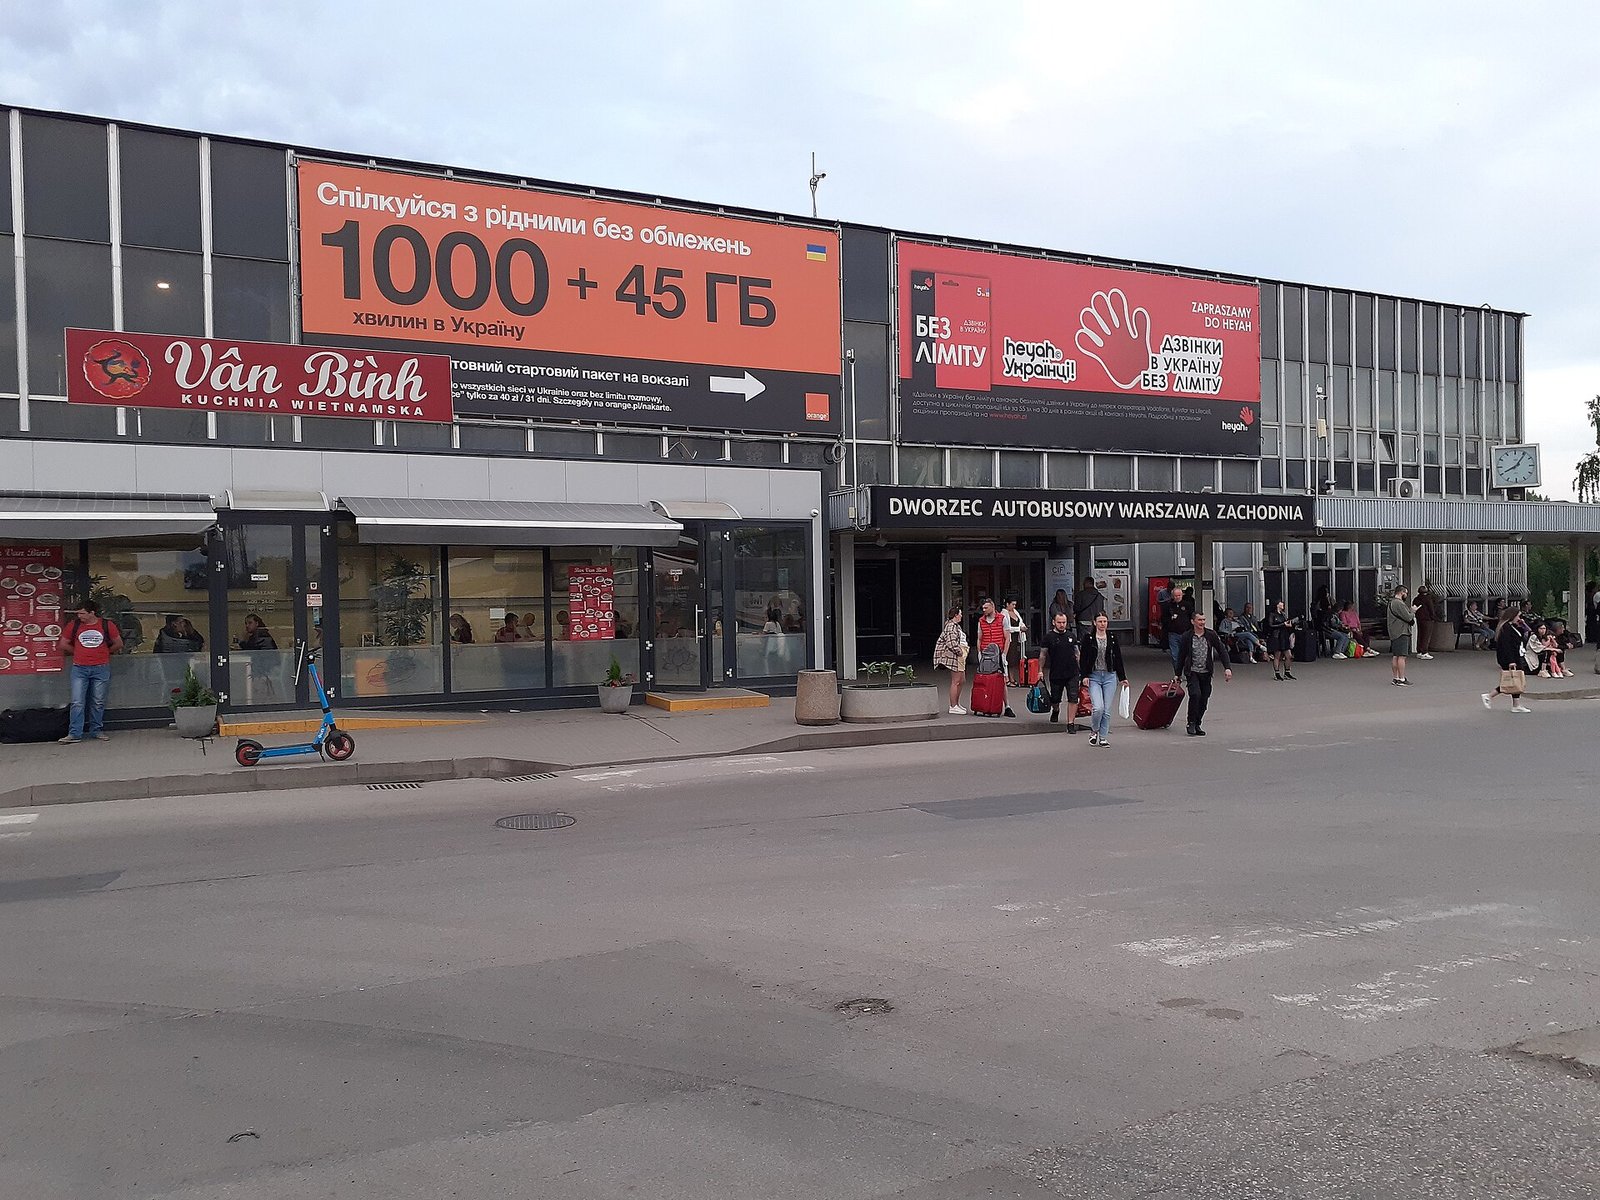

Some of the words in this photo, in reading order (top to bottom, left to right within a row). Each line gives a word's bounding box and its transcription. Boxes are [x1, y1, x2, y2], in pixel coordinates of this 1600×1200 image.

[317, 182, 457, 220] Спілкуйся
[463, 205, 479, 222] з
[485, 204, 587, 235] рідними
[593, 217, 634, 241] без
[640, 225, 752, 256] обмежень
[321, 219, 550, 317] 1000
[615, 264, 687, 320] 45
[705, 271, 777, 328] ГБ
[1191, 301, 1252, 319] ZAPRASZAMY
[352, 311, 428, 330] хвилин
[433, 318, 446, 332] в
[451, 316, 526, 342] Україну
[916, 314, 952, 340] БЕЗ
[1204, 316, 1221, 329] DO
[1222, 318, 1252, 332] HEYAH
[915, 341, 987, 369] ЛІМІТУ
[1005, 339, 1056, 363] heyah
[1162, 337, 1222, 356] ДЗВІНКИ
[165, 340, 283, 393] Vân
[299, 351, 427, 402] Bình
[451, 359, 504, 373] товний
[506, 363, 580, 378] стартовий
[582, 369, 621, 382] пакет
[622, 372, 639, 383] на
[641, 374, 689, 387] вокзалі
[1004, 357, 1076, 381] Українці!
[1151, 355, 1159, 370] В
[1163, 356, 1221, 375] УКРАЇНУ
[459, 382, 506, 393] wszystkich
[507, 385, 527, 394] sieci
[537, 386, 570, 397] Ukrainie
[571, 390, 589, 398] oraz
[589, 390, 604, 399] bez
[605, 391, 627, 401] limitu
[1142, 373, 1167, 388] БЕЗ
[1175, 375, 1221, 392] ЛІМІТУ
[181, 393, 278, 409] KUCHNIA
[291, 399, 424, 416] WIETNAMSKA
[466, 391, 487, 401] tylko
[499, 393, 510, 401] 40
[525, 395, 535, 403] 31
[1221, 420, 1246, 433] heyah
[889, 497, 983, 517] DWORZEC
[991, 499, 1115, 519] AUTOBUSOWY
[1118, 502, 1210, 520] WARSZAWA
[1216, 504, 1304, 521] ZACHODNIA
